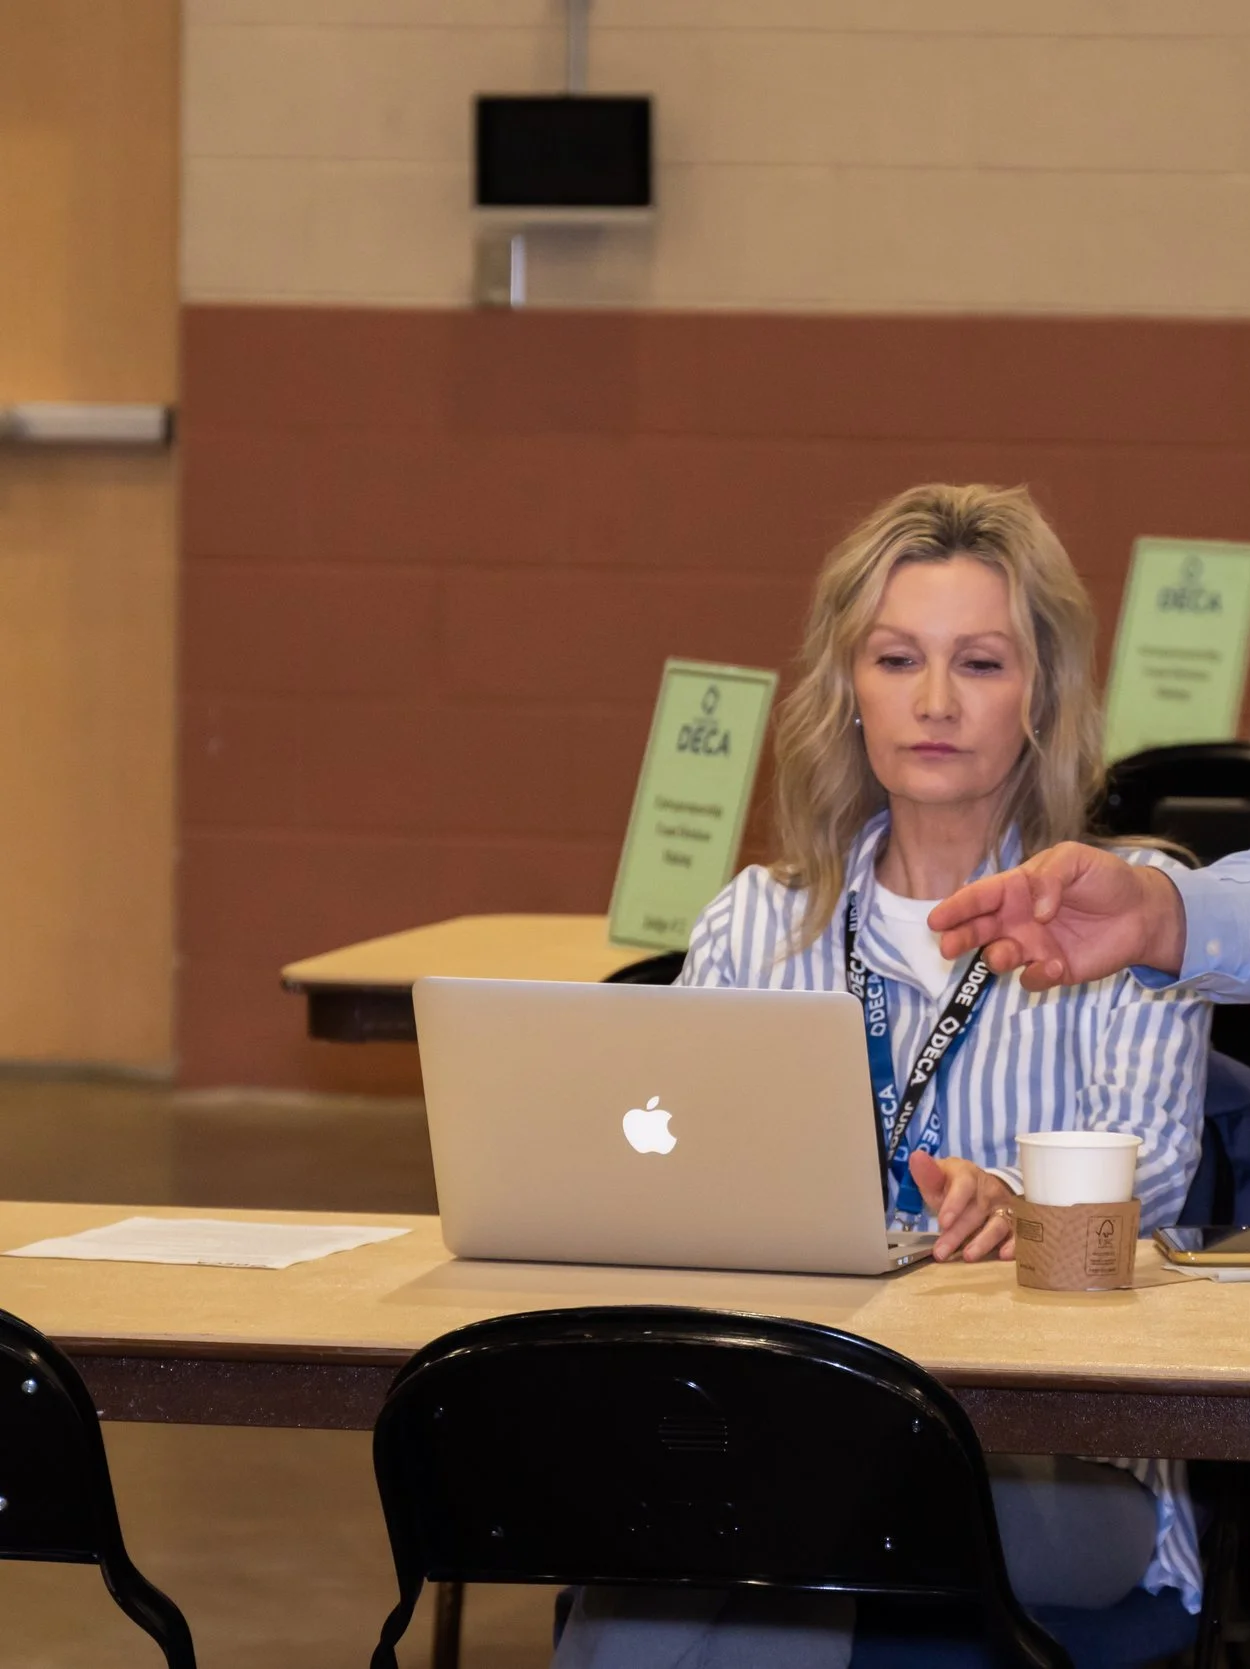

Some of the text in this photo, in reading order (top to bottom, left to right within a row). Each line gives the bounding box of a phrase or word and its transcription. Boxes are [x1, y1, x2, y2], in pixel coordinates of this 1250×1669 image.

[676, 723, 731, 757] DECA
[955, 957, 989, 1007] UDGE
[911, 1032, 953, 1087] DECA
